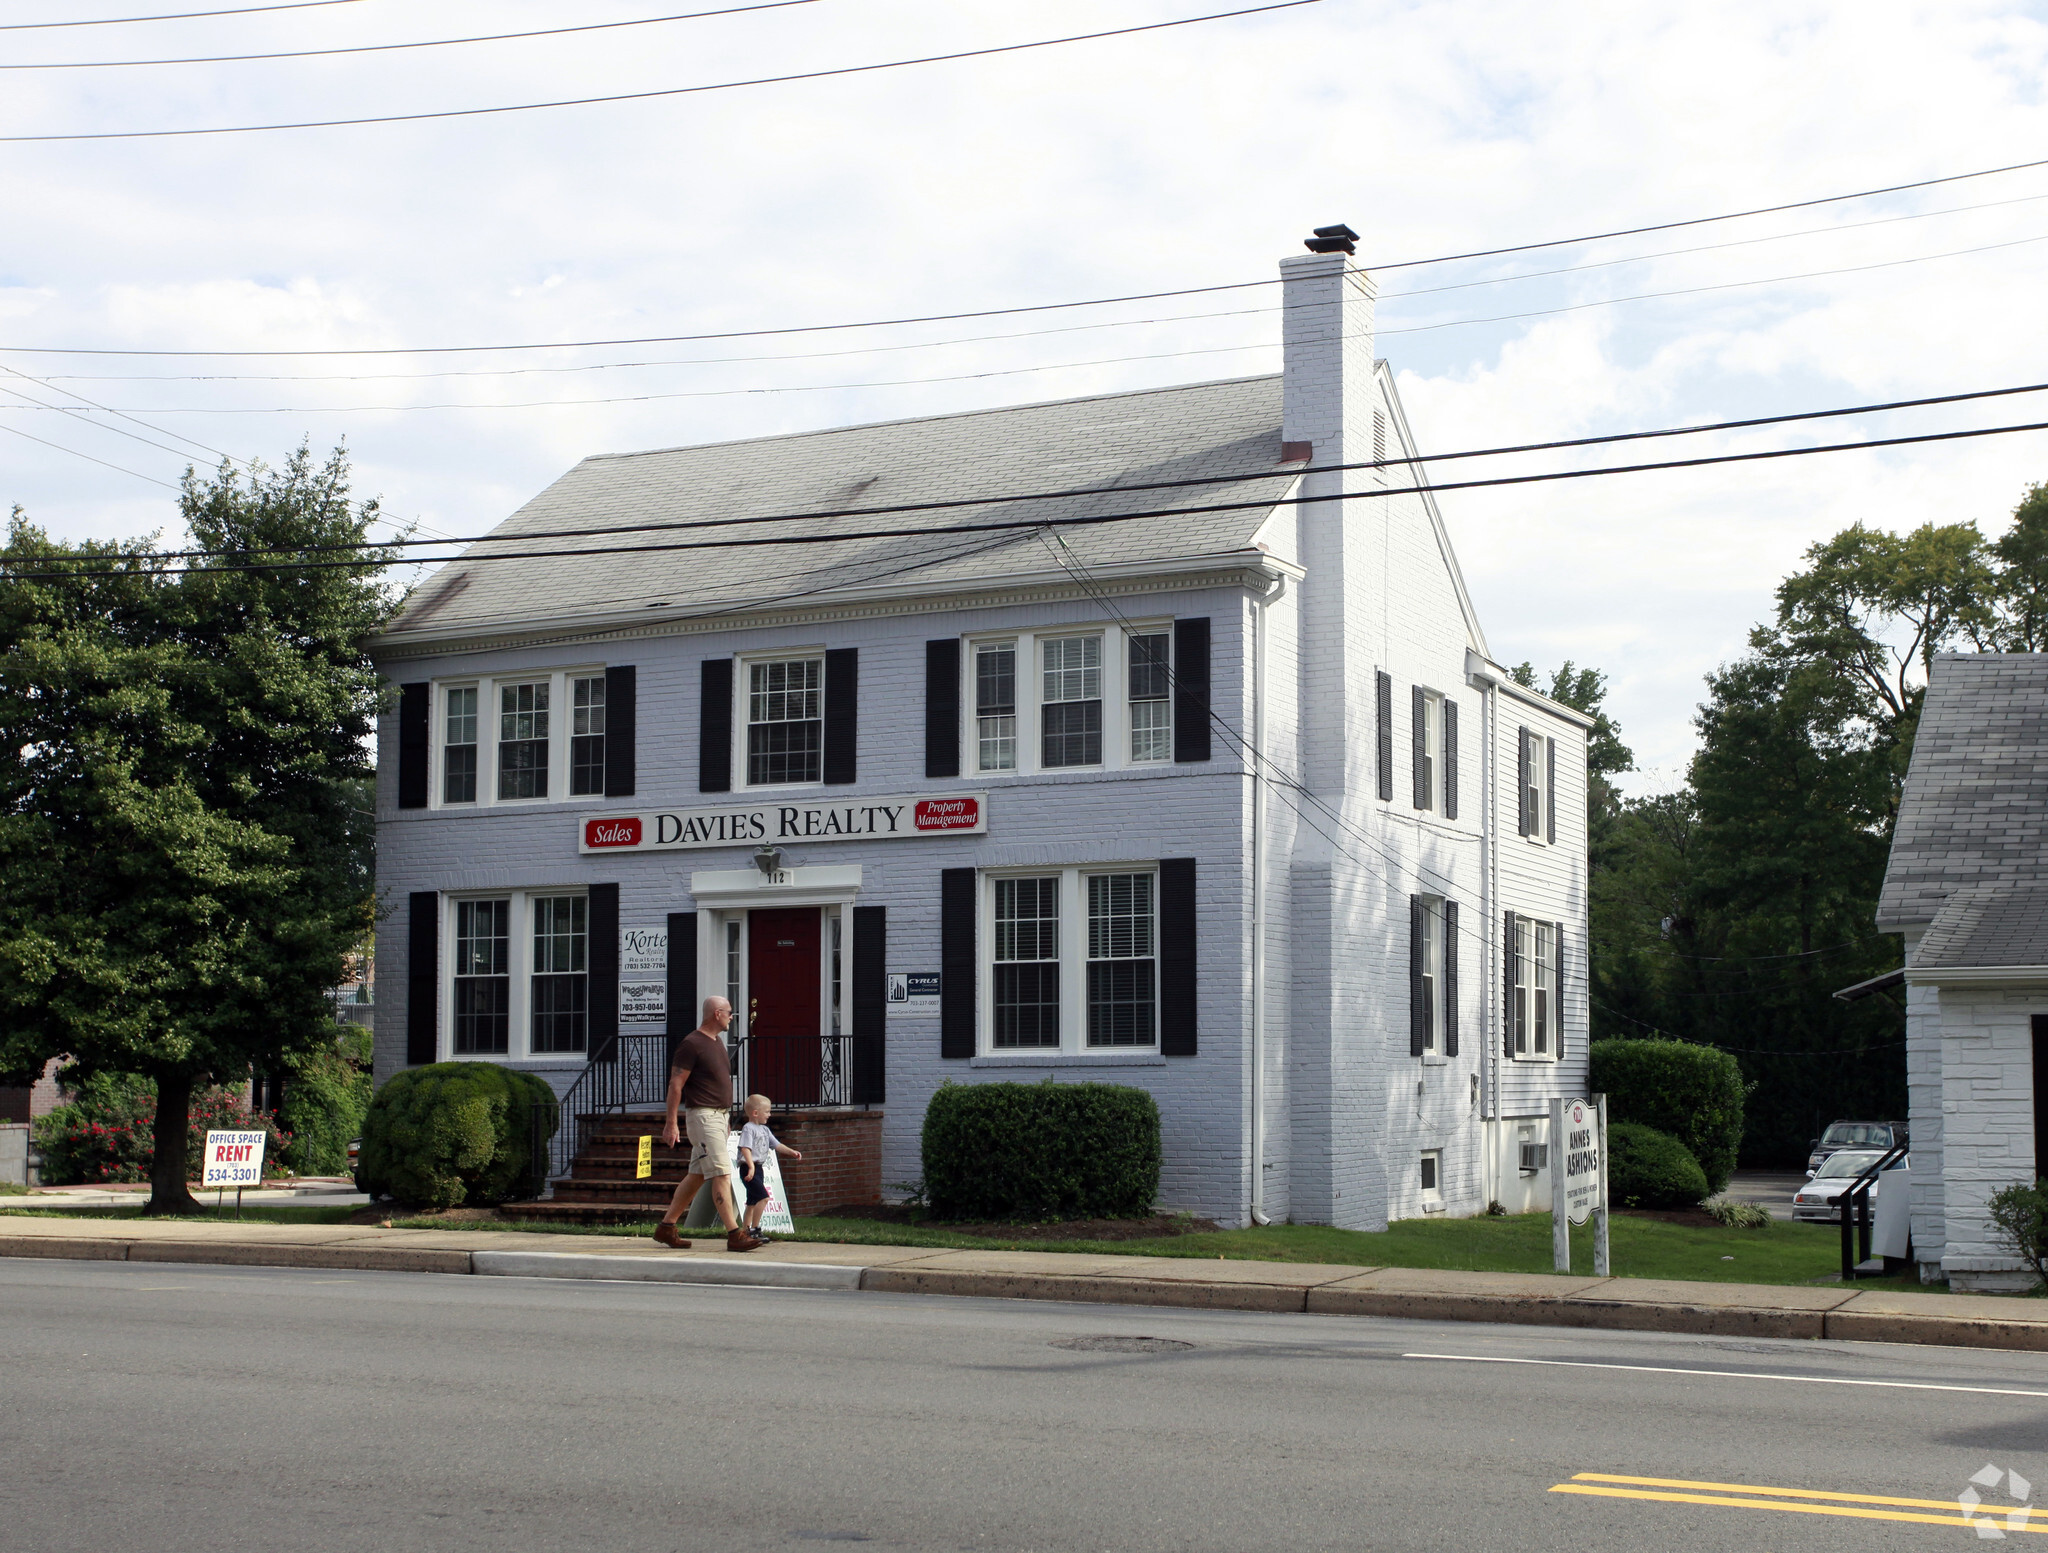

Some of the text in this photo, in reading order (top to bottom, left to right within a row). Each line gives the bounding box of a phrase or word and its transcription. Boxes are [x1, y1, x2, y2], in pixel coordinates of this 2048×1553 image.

[927, 801, 966, 816] Property
[655, 806, 905, 844] DAVIES REALTY
[917, 812, 977, 828] Management
[594, 823, 633, 843] Sales
[767, 872, 784, 884] 712
[624, 930, 667, 955] Korte
[622, 1003, 664, 1011] 703-957-0044
[209, 1134, 263, 1144] OFFICE SPACE
[216, 1145, 253, 1162] RENT
[1566, 1149, 1597, 1177] ASHIONS
[207, 1168, 257, 1182] 534-3301
